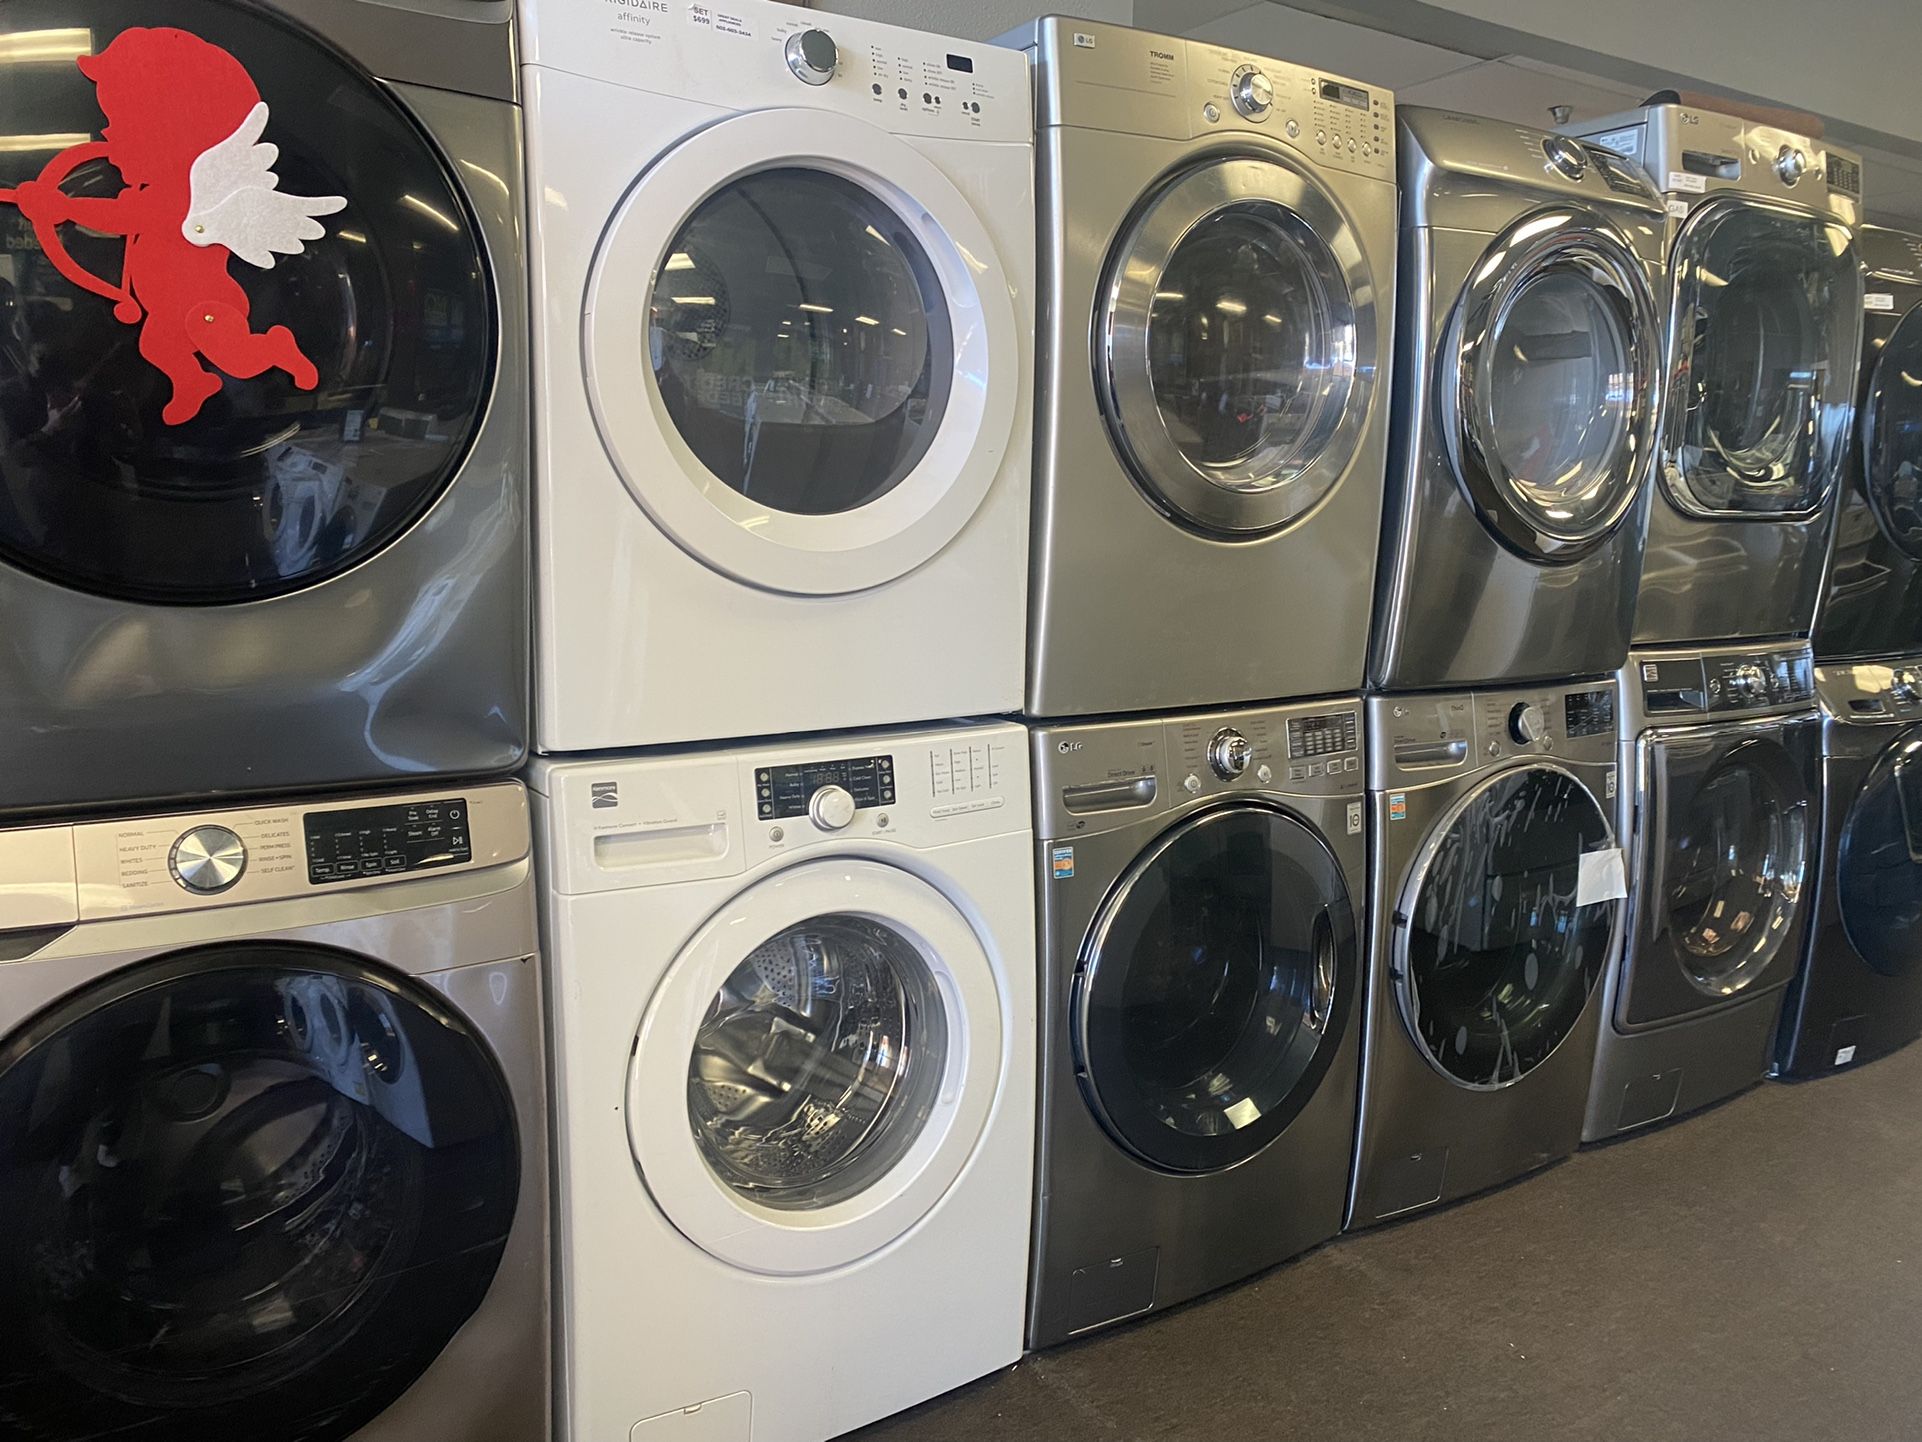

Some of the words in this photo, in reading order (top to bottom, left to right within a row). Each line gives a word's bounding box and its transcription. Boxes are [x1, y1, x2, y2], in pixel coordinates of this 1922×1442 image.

[694, 6, 708, 16] SET
[617, 12, 650, 26] affinity
[693, 15, 710, 25] $699
[1149, 50, 1174, 61] TROMM
[260, 831, 290, 839] DELICATES
